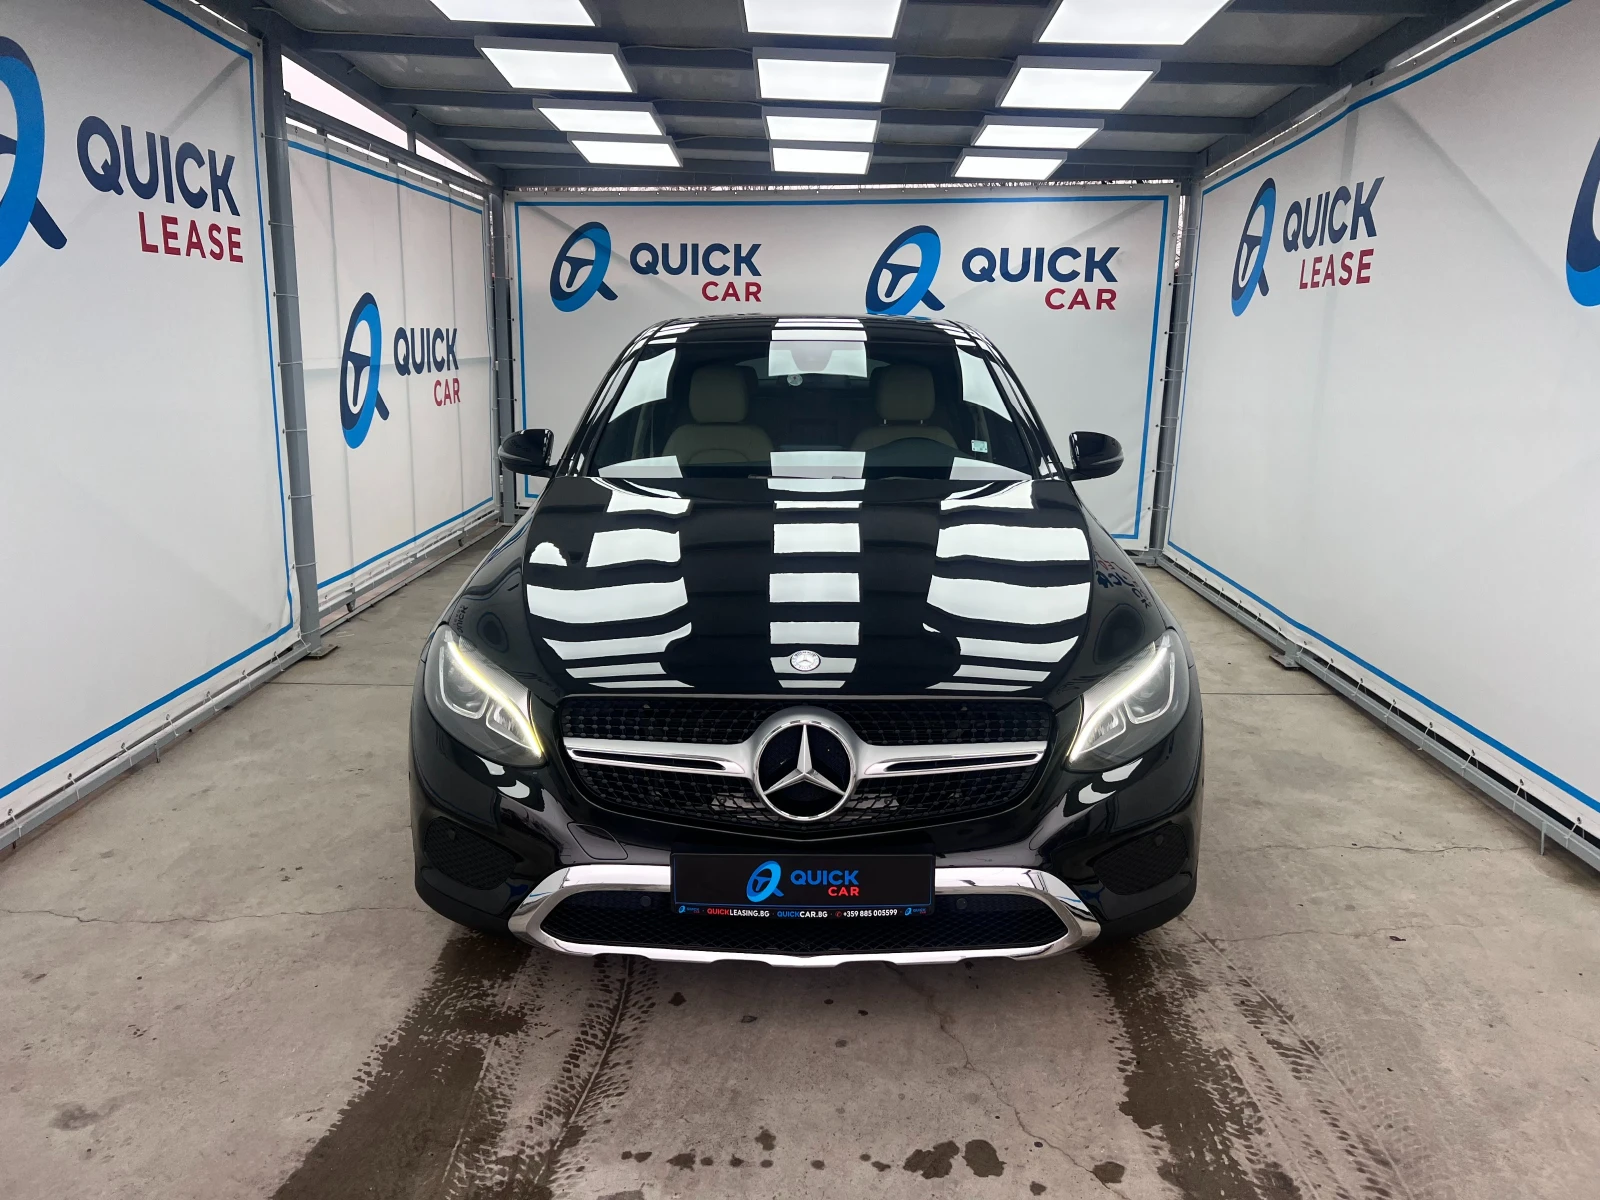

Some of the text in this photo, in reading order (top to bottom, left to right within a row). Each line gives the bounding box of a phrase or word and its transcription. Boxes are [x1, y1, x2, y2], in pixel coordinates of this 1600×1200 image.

[77, 115, 240, 217] QUICK
[1283, 177, 1384, 252] QUICK
[139, 212, 244, 263] LEASE
[629, 243, 761, 277] QUICK
[962, 246, 1119, 283] QUICK
[1299, 248, 1374, 290] LEASE
[701, 280, 762, 303] CAR
[1045, 287, 1117, 311] CAR
[393, 327, 459, 377] QUICK
[433, 377, 460, 406] CAR
[790, 869, 859, 886] QUICK
[827, 886, 860, 897] CAR
[706, 908, 770, 918] QUICKLEASING.BG
[776, 910, 828, 918] QUICKCAR.BG
[843, 910, 858, 918] +359
[873, 908, 898, 917] 005599
